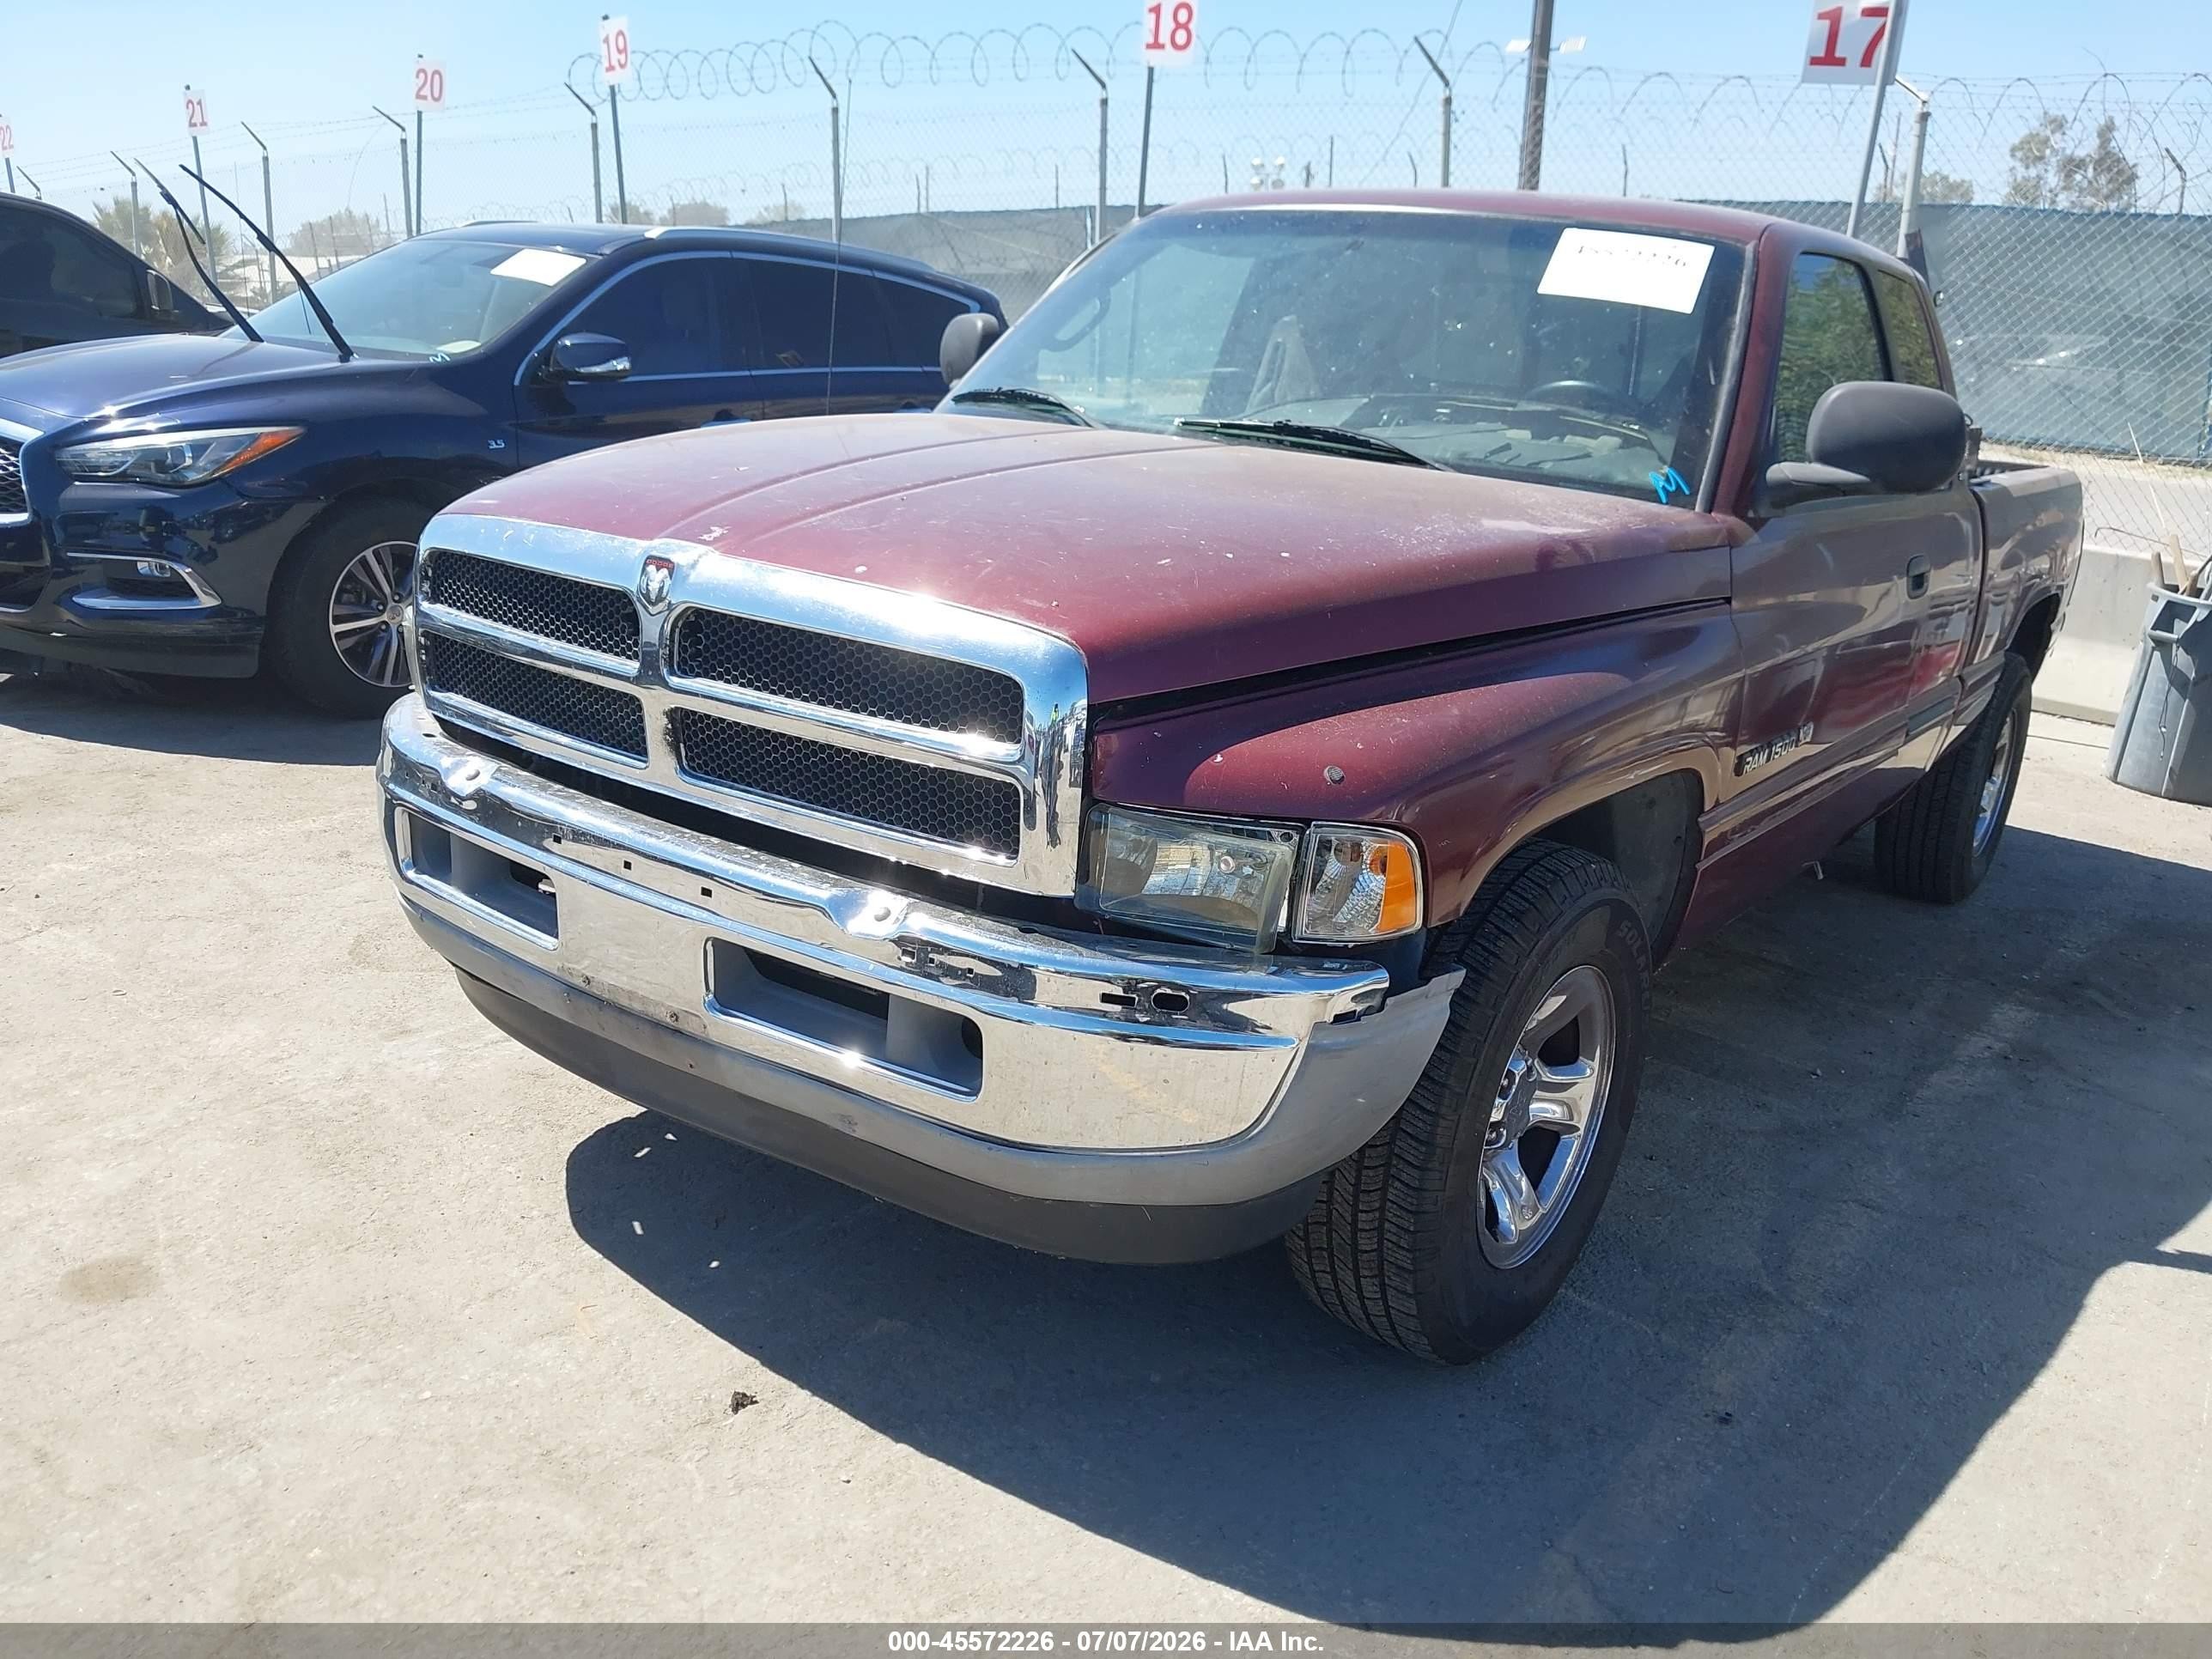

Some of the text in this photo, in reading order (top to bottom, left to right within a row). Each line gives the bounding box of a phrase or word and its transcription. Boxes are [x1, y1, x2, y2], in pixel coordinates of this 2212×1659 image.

[1146, 3, 1193, 51] 18
[1809, 6, 1889, 68] 17
[603, 29, 628, 72] 19
[416, 69, 443, 102] 20
[186, 99, 208, 127] 21
[1649, 467, 1690, 504] M
[1743, 736, 1796, 775] RAM 1500
